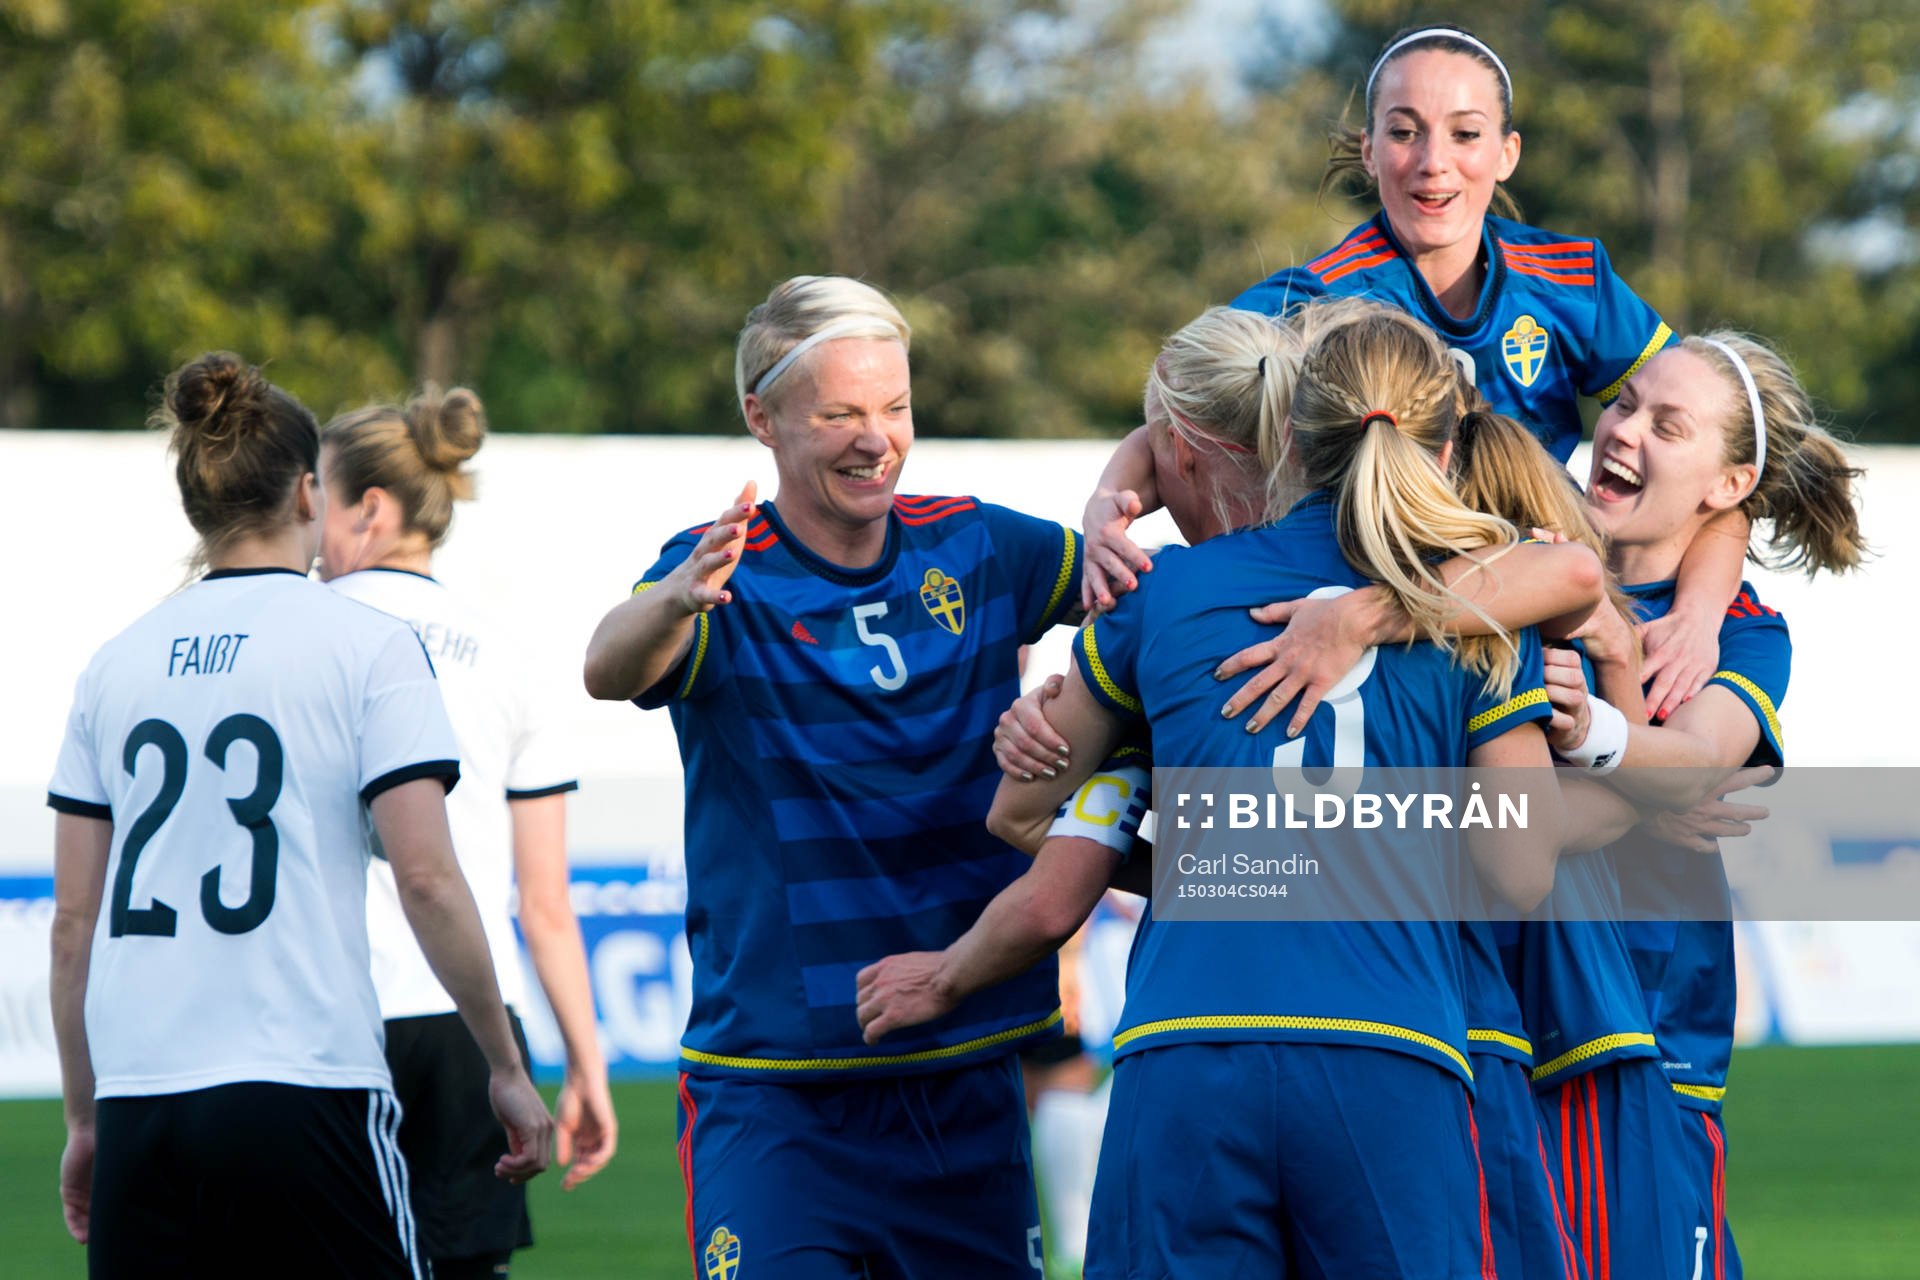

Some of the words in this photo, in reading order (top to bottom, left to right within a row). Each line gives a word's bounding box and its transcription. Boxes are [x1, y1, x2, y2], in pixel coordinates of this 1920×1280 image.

[412, 620, 480, 668] EHR
[852, 600, 909, 692] 5
[109, 712, 285, 938] 23
[1073, 774, 1131, 827] C
